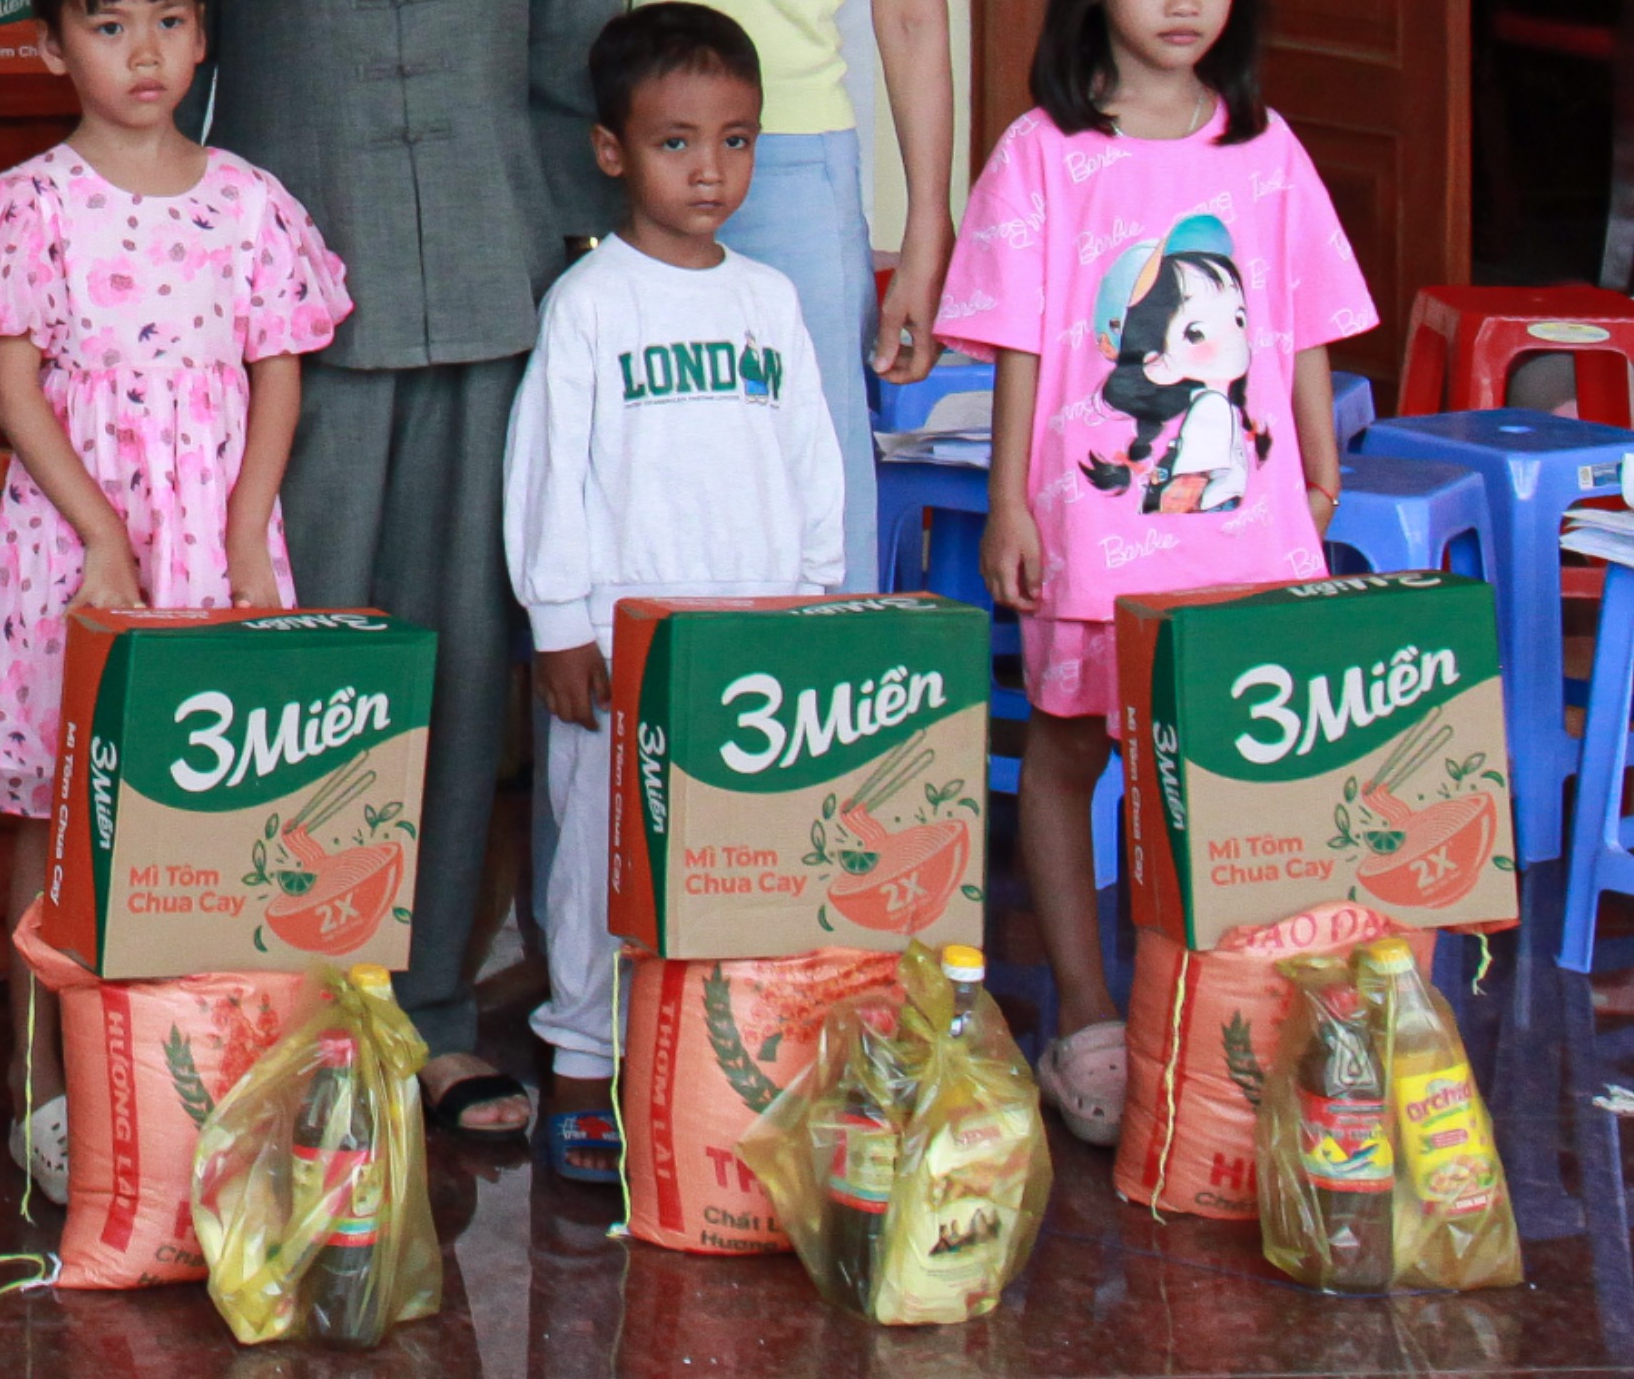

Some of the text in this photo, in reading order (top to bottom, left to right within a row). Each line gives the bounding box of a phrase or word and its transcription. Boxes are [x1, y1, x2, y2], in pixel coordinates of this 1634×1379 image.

[720, 665, 951, 778] 3Miền
[1231, 645, 1464, 768] 3Miền
[170, 686, 394, 796] 3Miền
[50, 804, 69, 906] Chua Cay
[684, 846, 778, 868] Mì Tôm
[1208, 834, 1303, 861] Mì Tôm
[1408, 846, 1458, 892] 2X
[129, 864, 219, 887] Mì Tôm
[684, 872, 807, 897] Chua Cay
[877, 872, 927, 919] 2X
[1211, 859, 1333, 886] Chua Cay
[127, 891, 246, 917] Chua Cay
[315, 893, 359, 939] 2X
